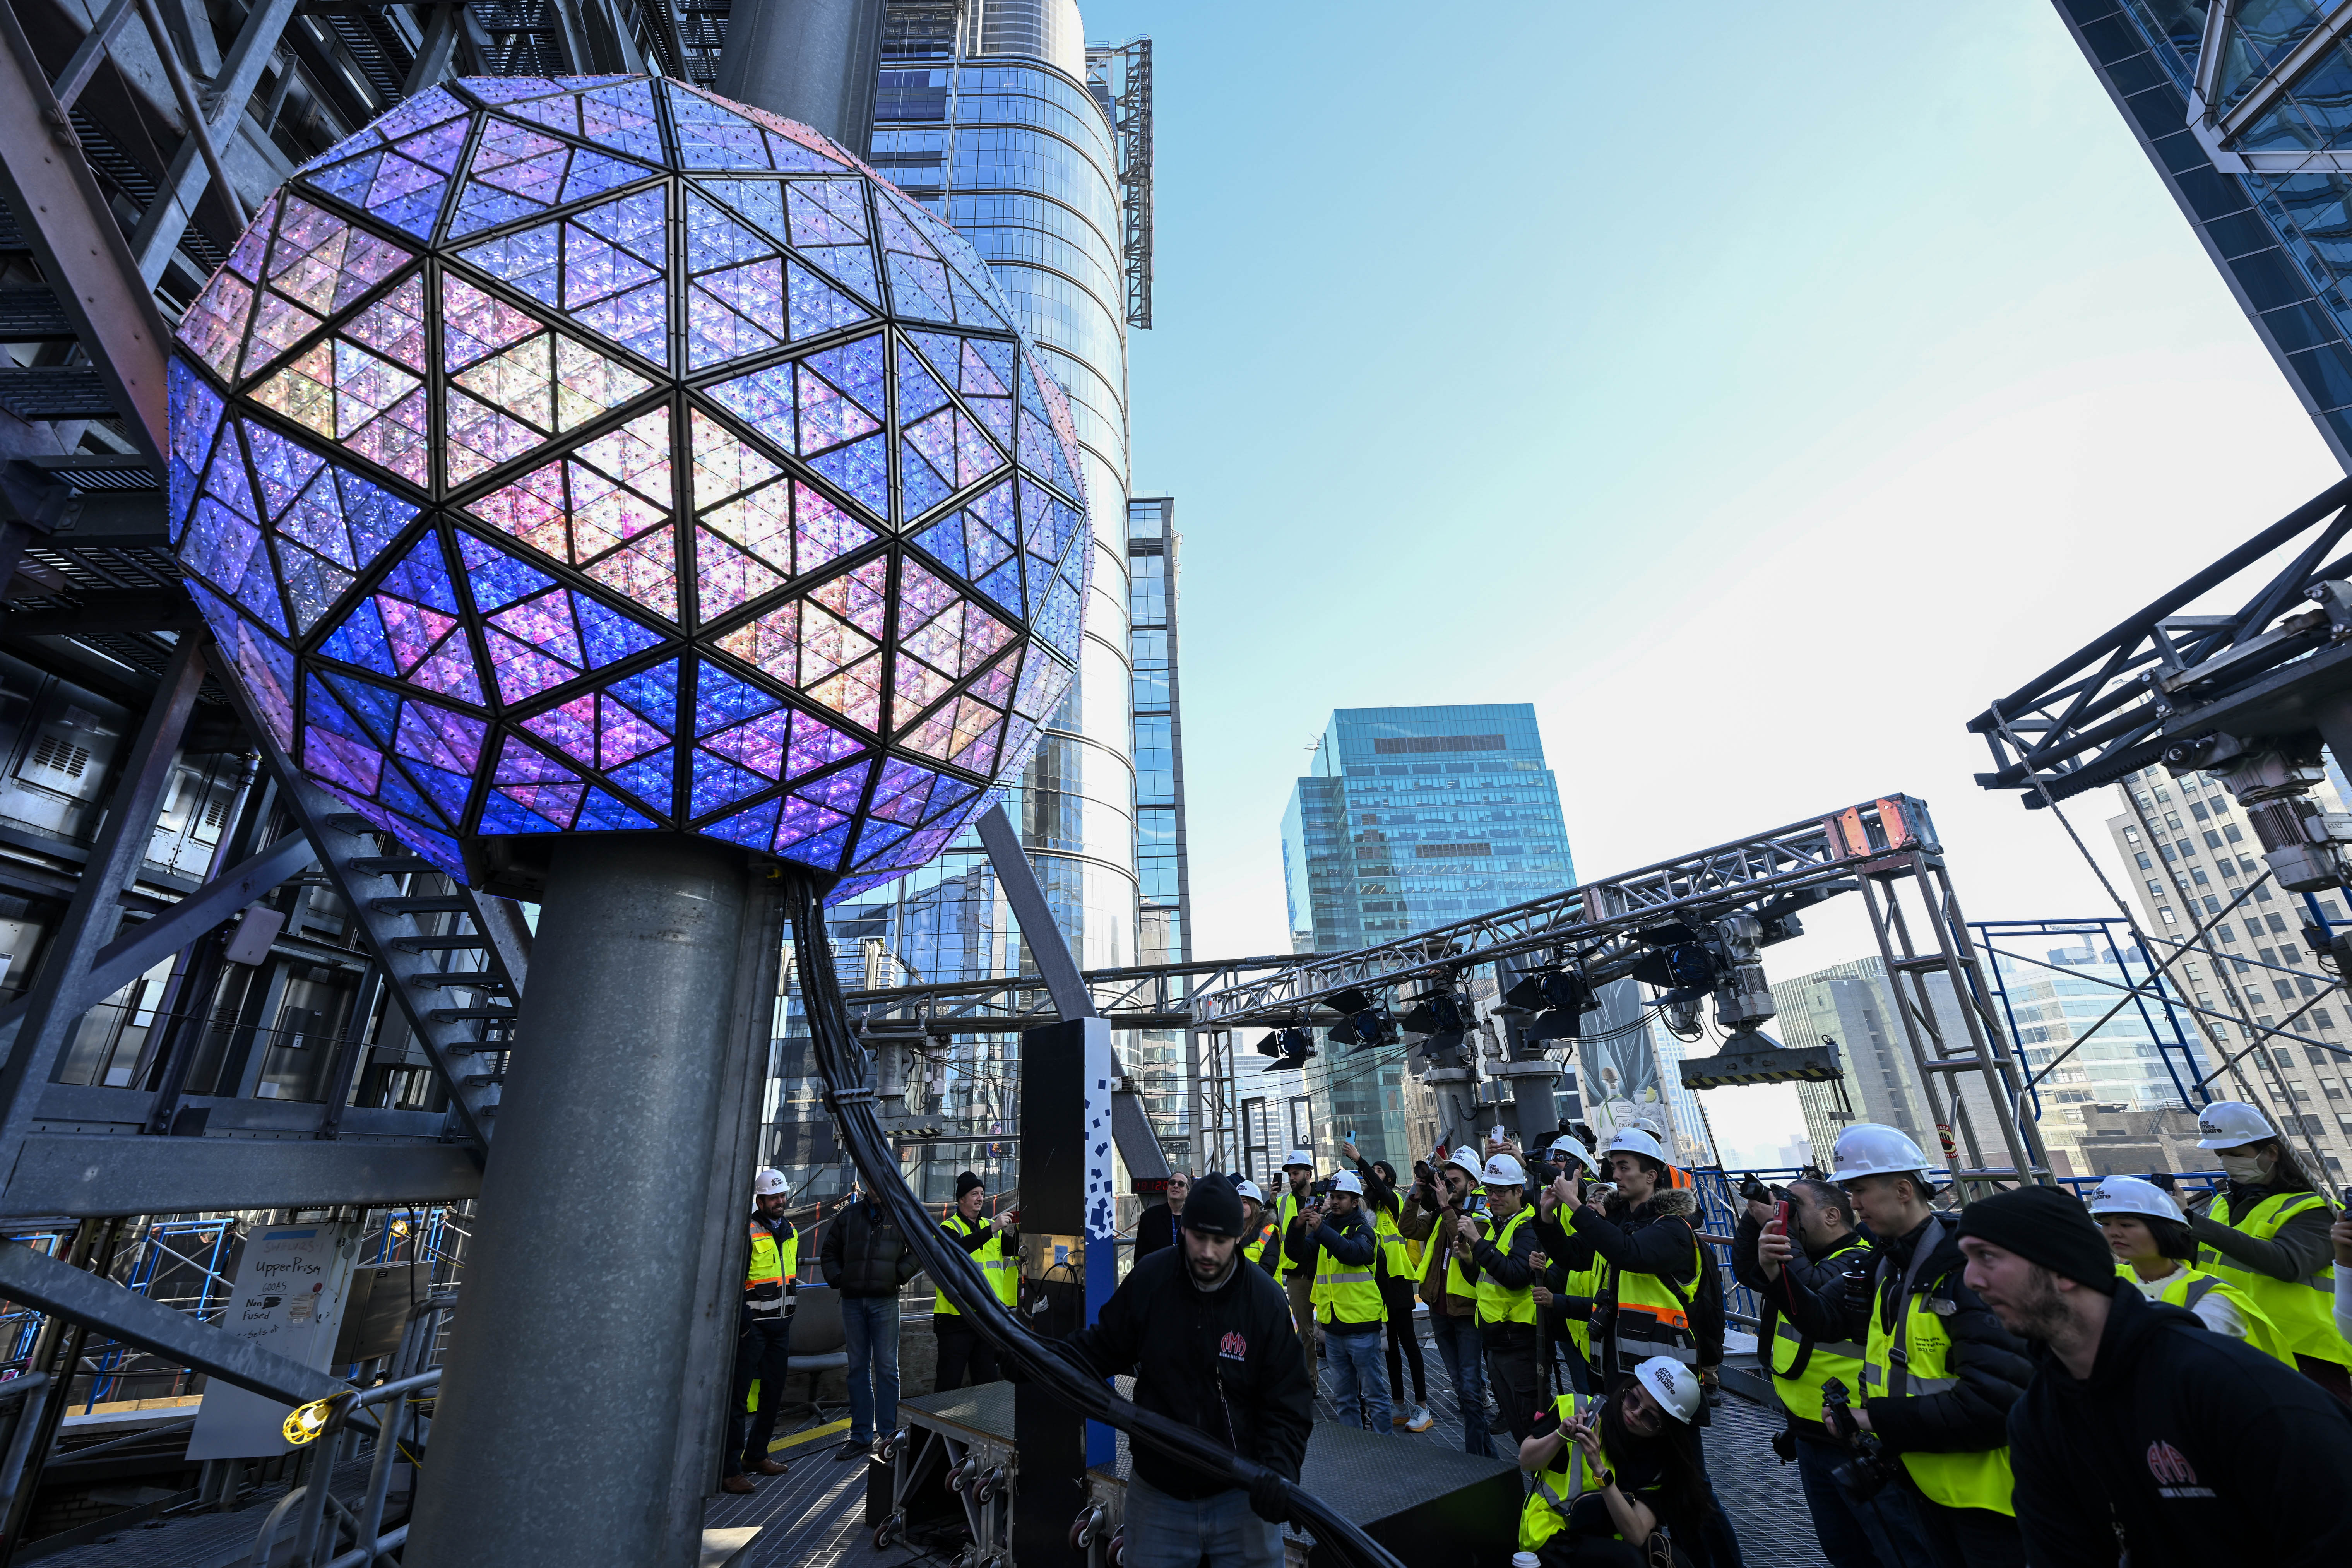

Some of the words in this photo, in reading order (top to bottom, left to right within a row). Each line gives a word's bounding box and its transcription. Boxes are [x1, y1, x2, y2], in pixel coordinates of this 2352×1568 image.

[246, 1299, 262, 1307] Non
[243, 1310, 270, 1320] Fused
[1221, 1330, 1246, 1357] AMA
[1654, 1371, 1676, 1395] square
[1658, 1368, 1675, 1387] times
[1662, 1367, 1674, 1380] one
[2147, 1439, 2197, 1485] AMA
